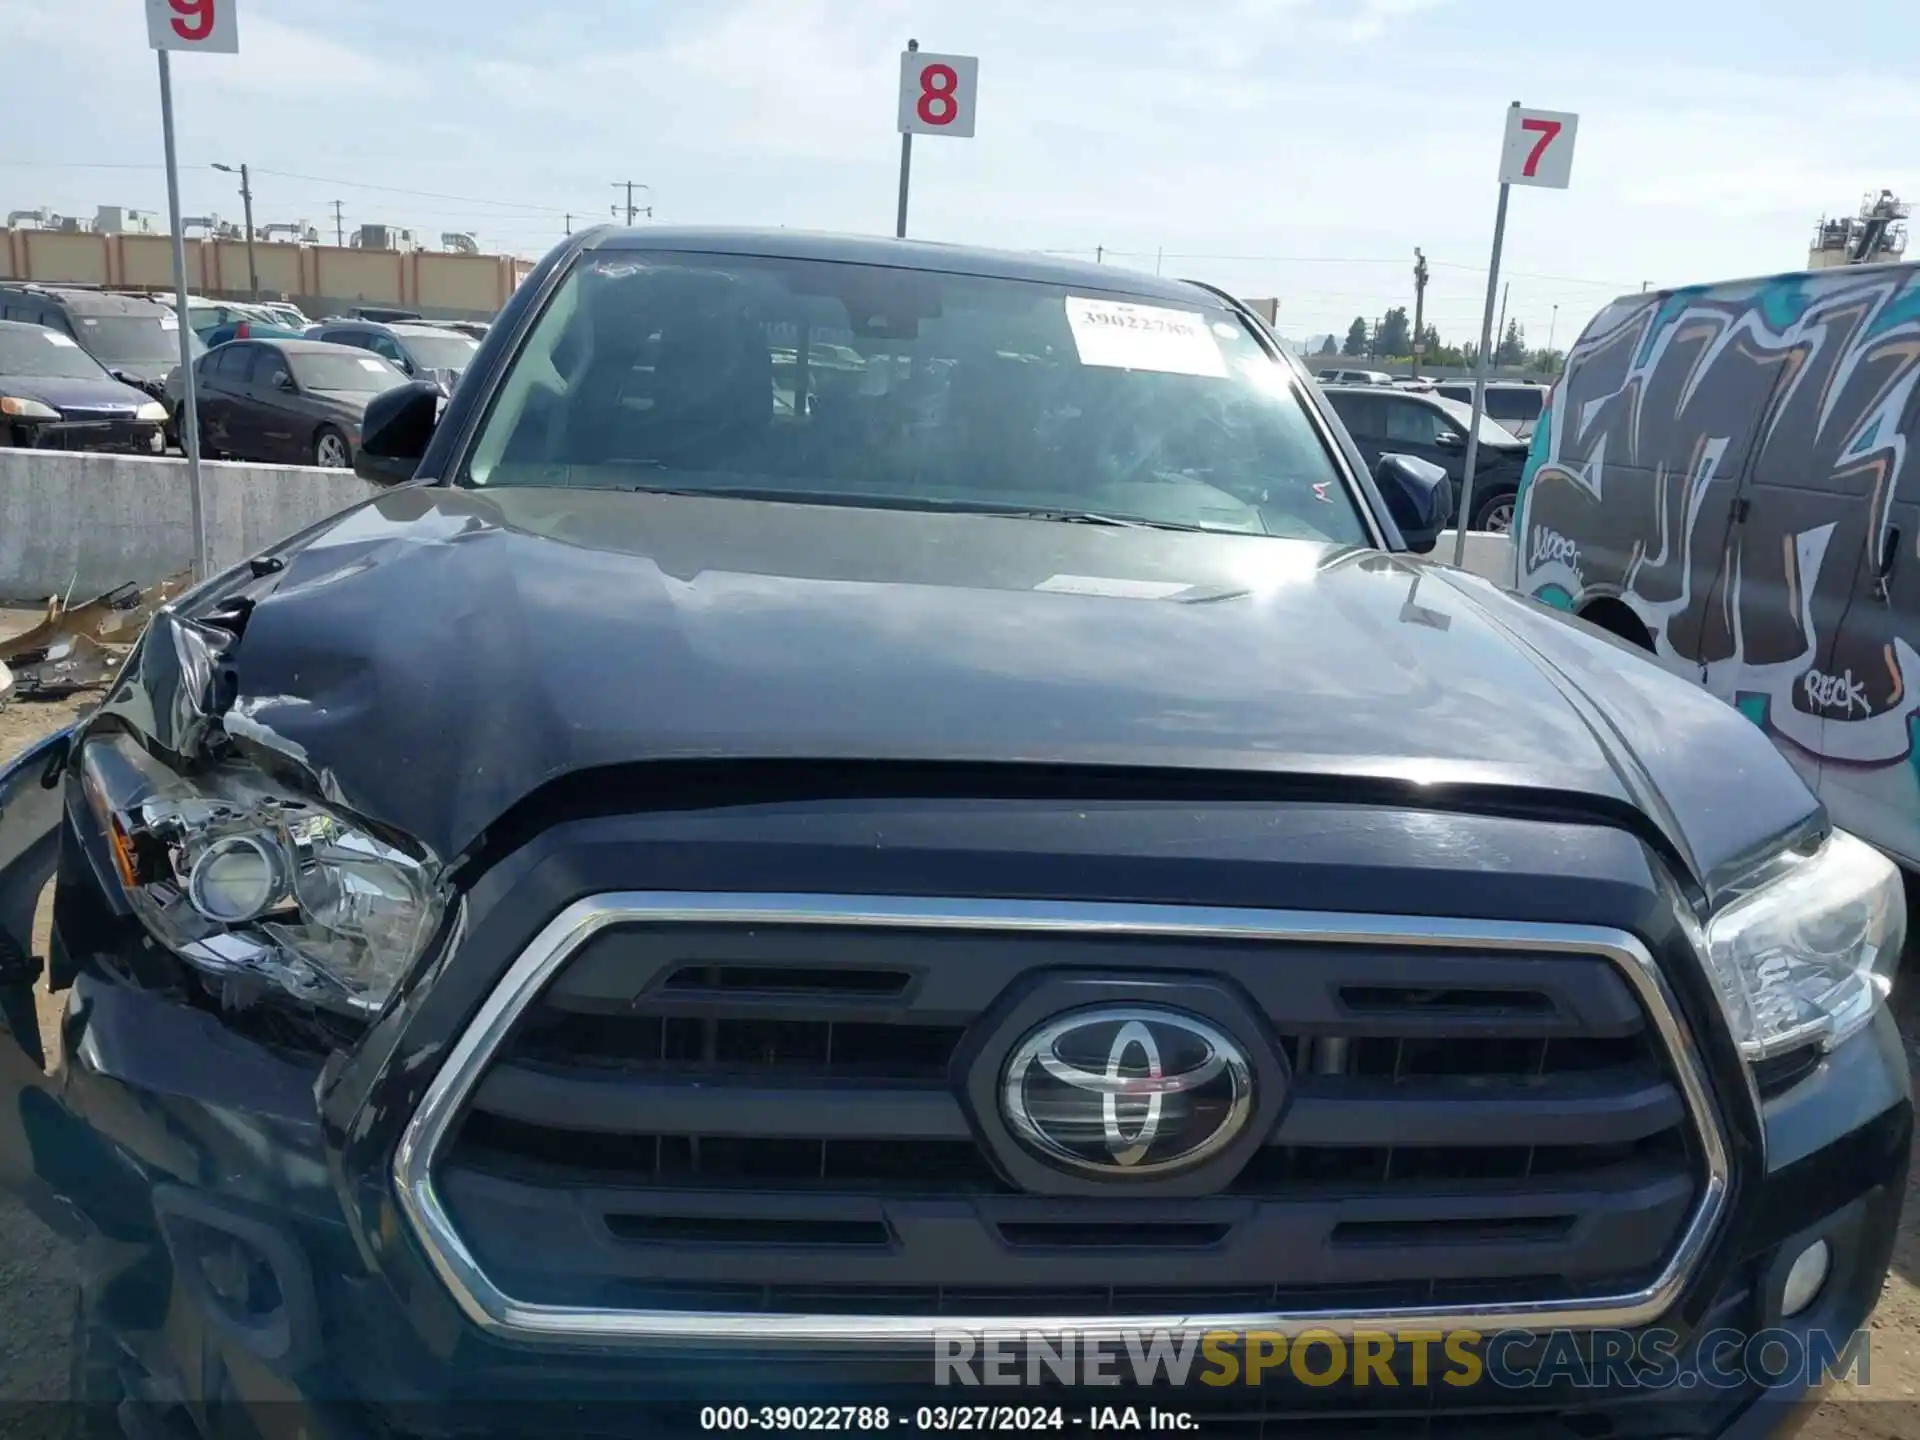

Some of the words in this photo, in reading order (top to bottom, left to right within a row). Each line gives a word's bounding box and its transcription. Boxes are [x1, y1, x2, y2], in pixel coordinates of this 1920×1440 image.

[168, 0, 214, 41] 9
[916, 63, 958, 126] 8
[1521, 118, 1562, 177] 7
